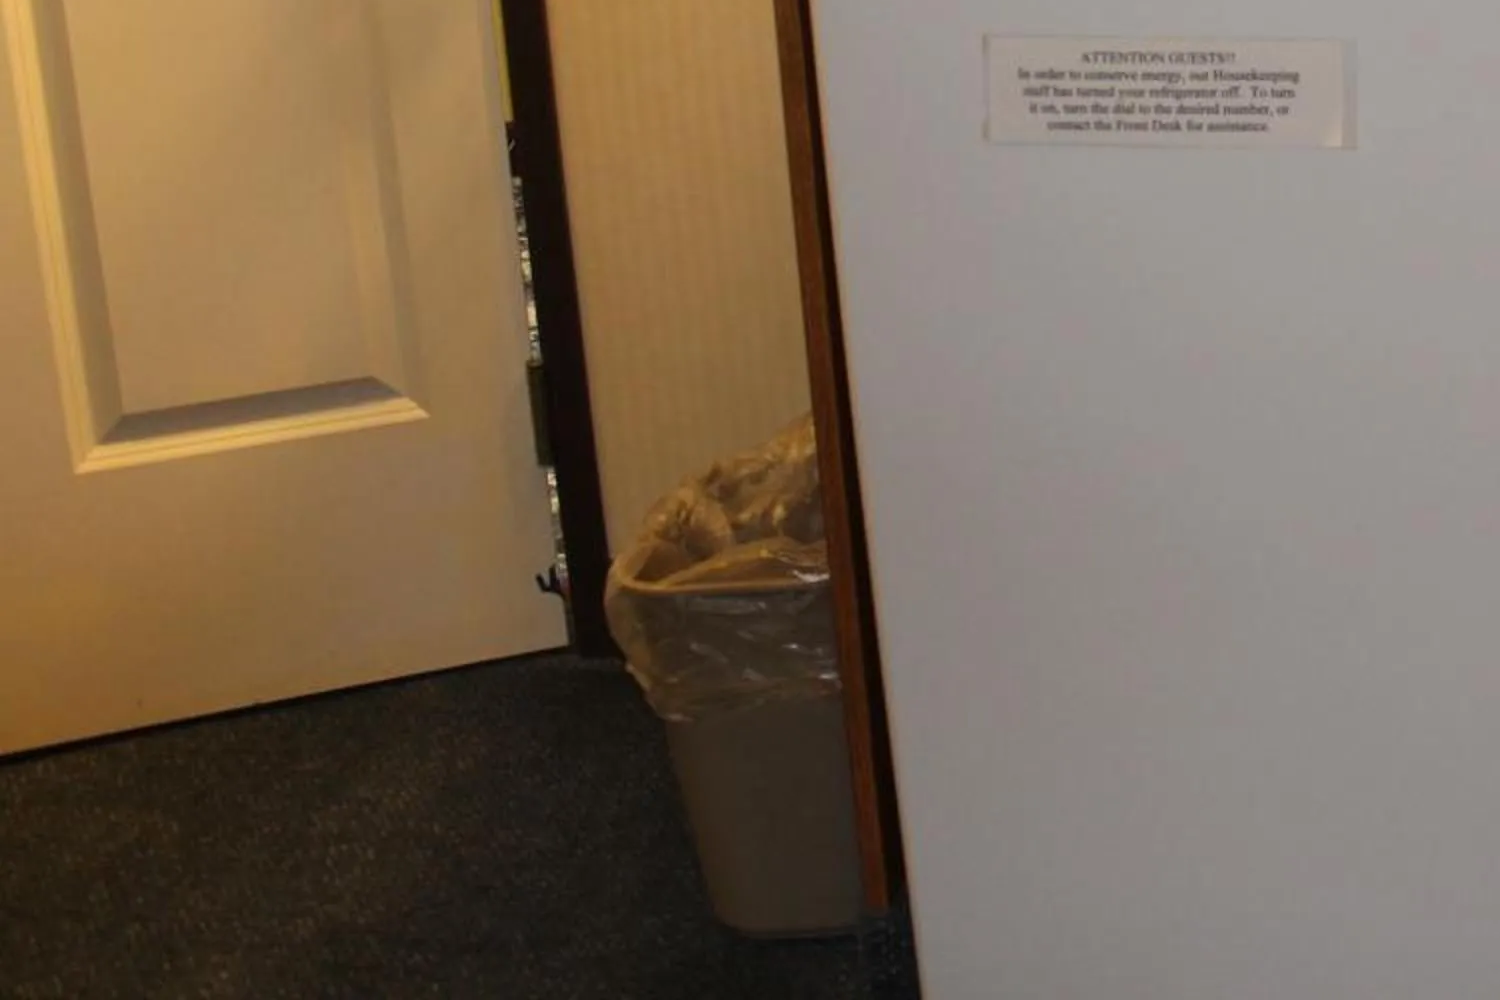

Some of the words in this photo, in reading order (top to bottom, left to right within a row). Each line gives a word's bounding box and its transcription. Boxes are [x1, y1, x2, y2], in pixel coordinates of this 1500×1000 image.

[1081, 51, 1165, 64] ATTENTION
[1018, 67, 1031, 80] In
[1034, 67, 1065, 80] order
[1069, 69, 1081, 80] to
[1084, 71, 1139, 81] conserve
[1213, 69, 1300, 84] Housekeeping
[1023, 85, 1051, 97] staff
[1053, 85, 1073, 97] has
[1076, 85, 1115, 97] turned
[1118, 88, 1145, 100] your
[1149, 86, 1218, 100] refrigerator
[1250, 86, 1268, 98] To
[1271, 87, 1296, 98] turn
[1063, 103, 1088, 114] turn
[1091, 102, 1109, 114] the
[1112, 102, 1136, 114] dial
[1139, 104, 1151, 114] to
[1154, 102, 1173, 114] the
[1175, 103, 1220, 115] desired
[1276, 105, 1290, 115] or
[1046, 119, 1091, 131] contact
[1093, 119, 1112, 131] the
[1116, 119, 1149, 131] Front
[1152, 119, 1182, 132] Desk
[1186, 120, 1203, 132] for
